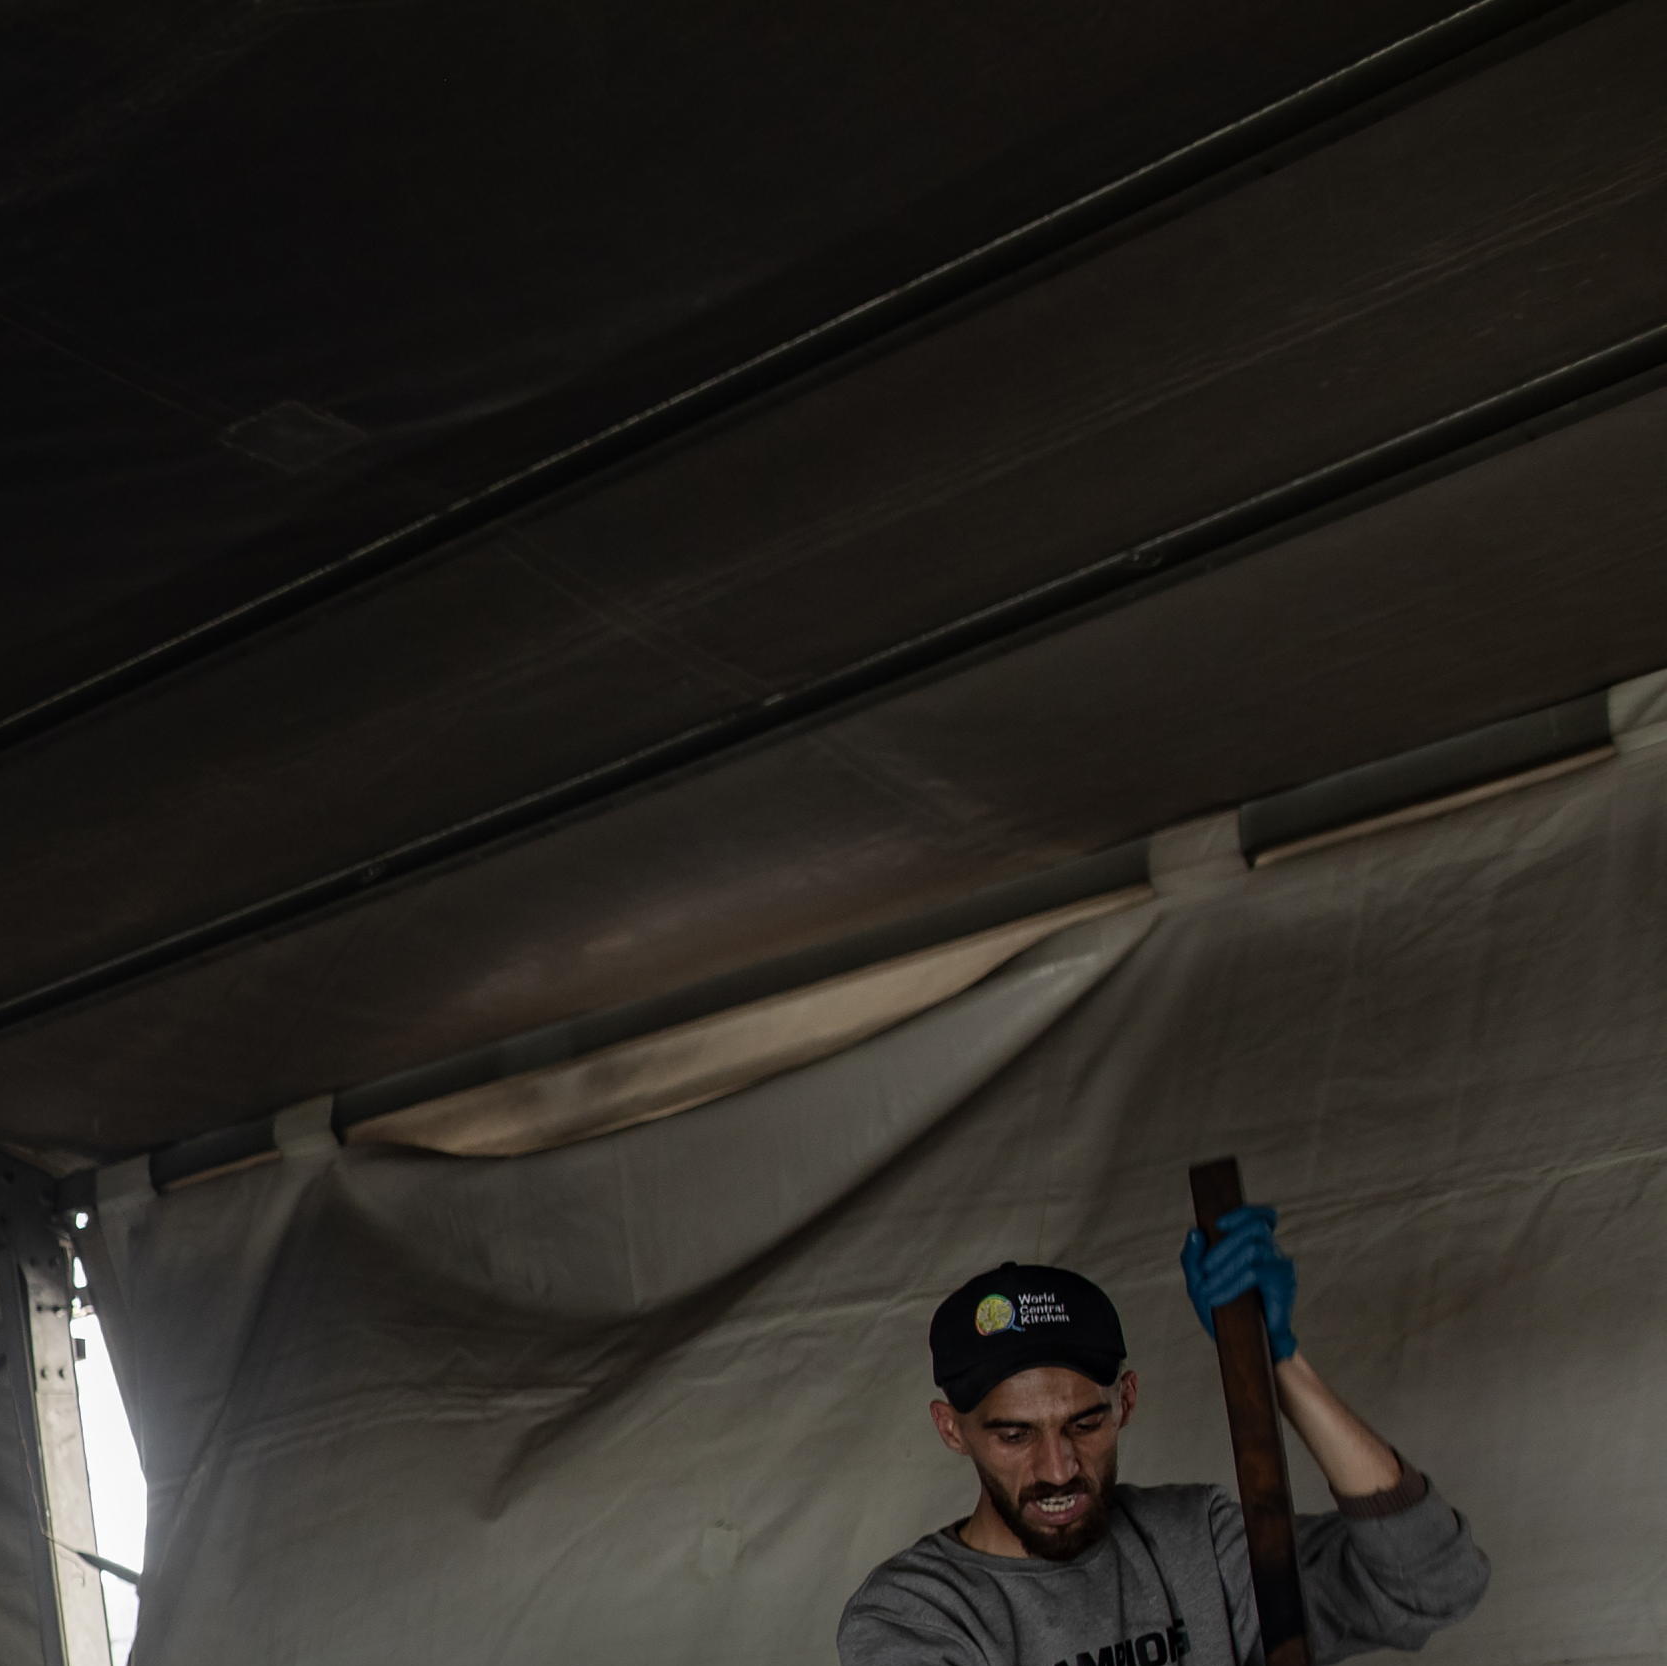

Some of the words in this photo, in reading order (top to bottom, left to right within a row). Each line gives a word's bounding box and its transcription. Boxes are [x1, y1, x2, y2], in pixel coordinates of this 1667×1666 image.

[1017, 1291, 1056, 1305] World
[1019, 1302, 1065, 1316] Central
[1020, 1312, 1071, 1326] Kitchen
